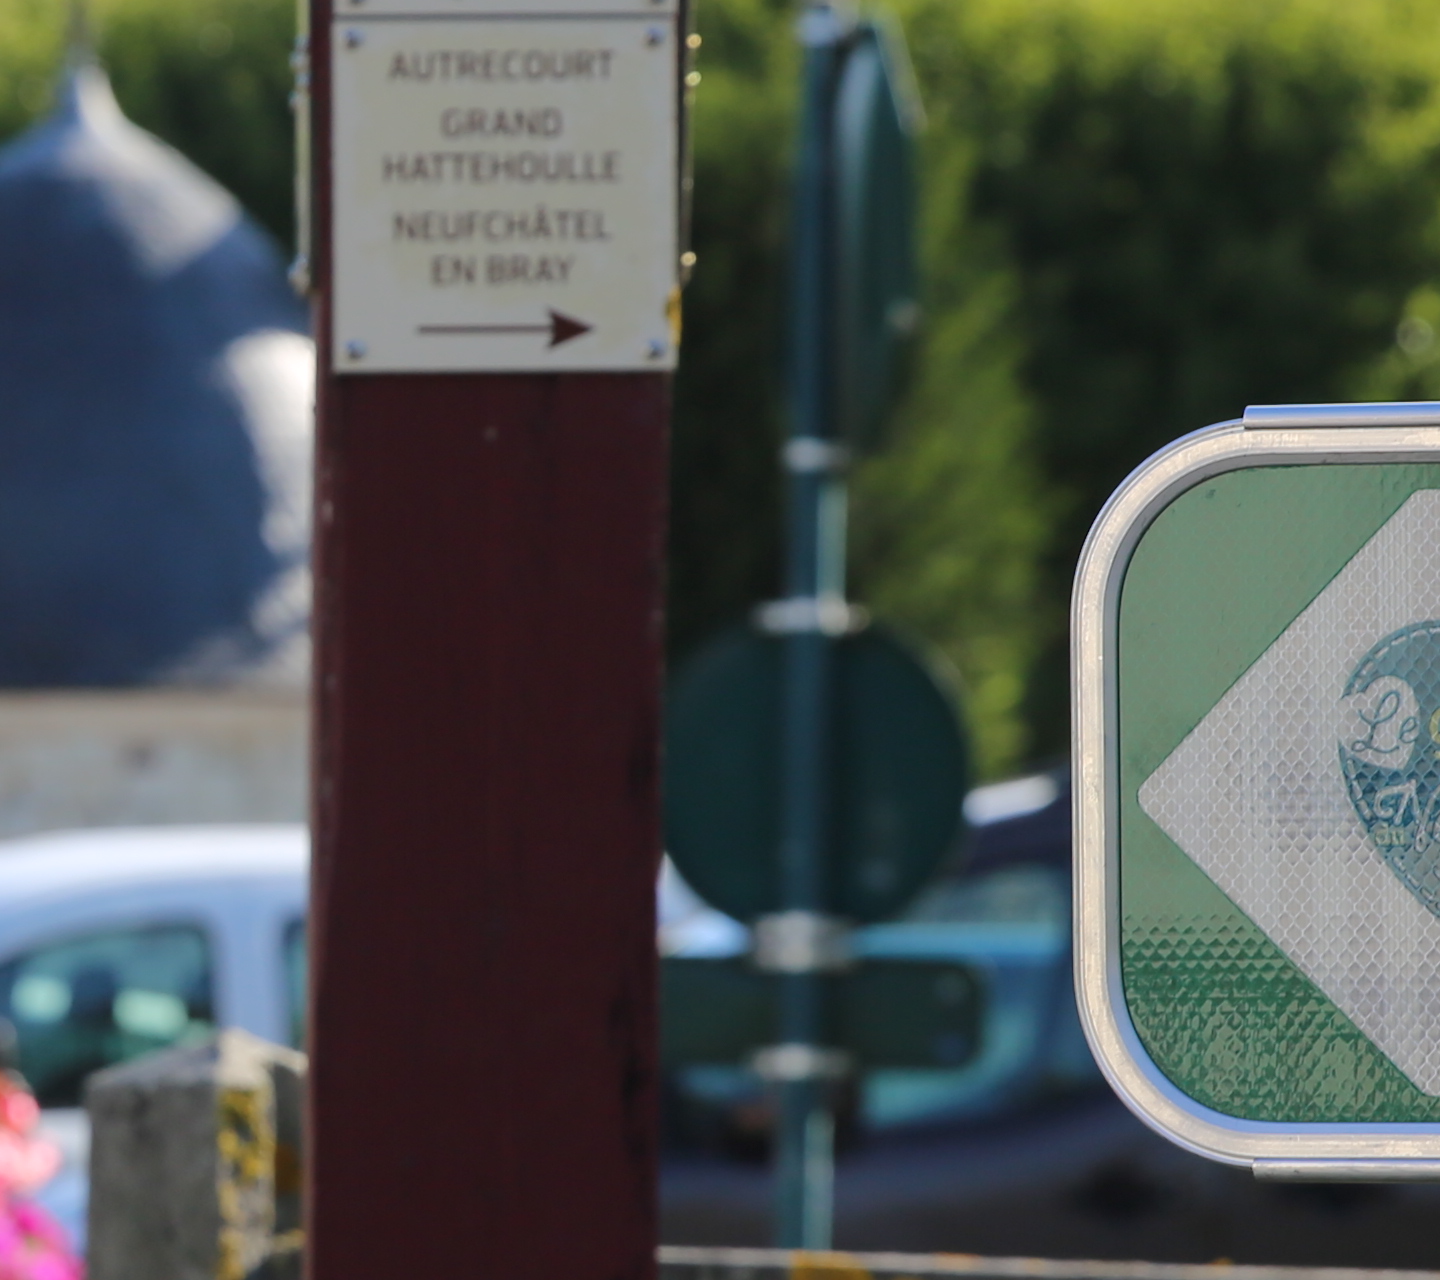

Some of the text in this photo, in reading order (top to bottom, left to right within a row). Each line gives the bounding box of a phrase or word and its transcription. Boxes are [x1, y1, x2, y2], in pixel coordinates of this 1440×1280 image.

[389, 49, 614, 81] AUTRECOURT
[440, 108, 563, 138] GRAND
[382, 151, 621, 183] HATTEHOULLE
[393, 205, 611, 242] NEUFCHÂTEL
[431, 254, 574, 285] EN BRAY
[1351, 689, 1419, 753] Le
[1375, 822, 1406, 846] du
